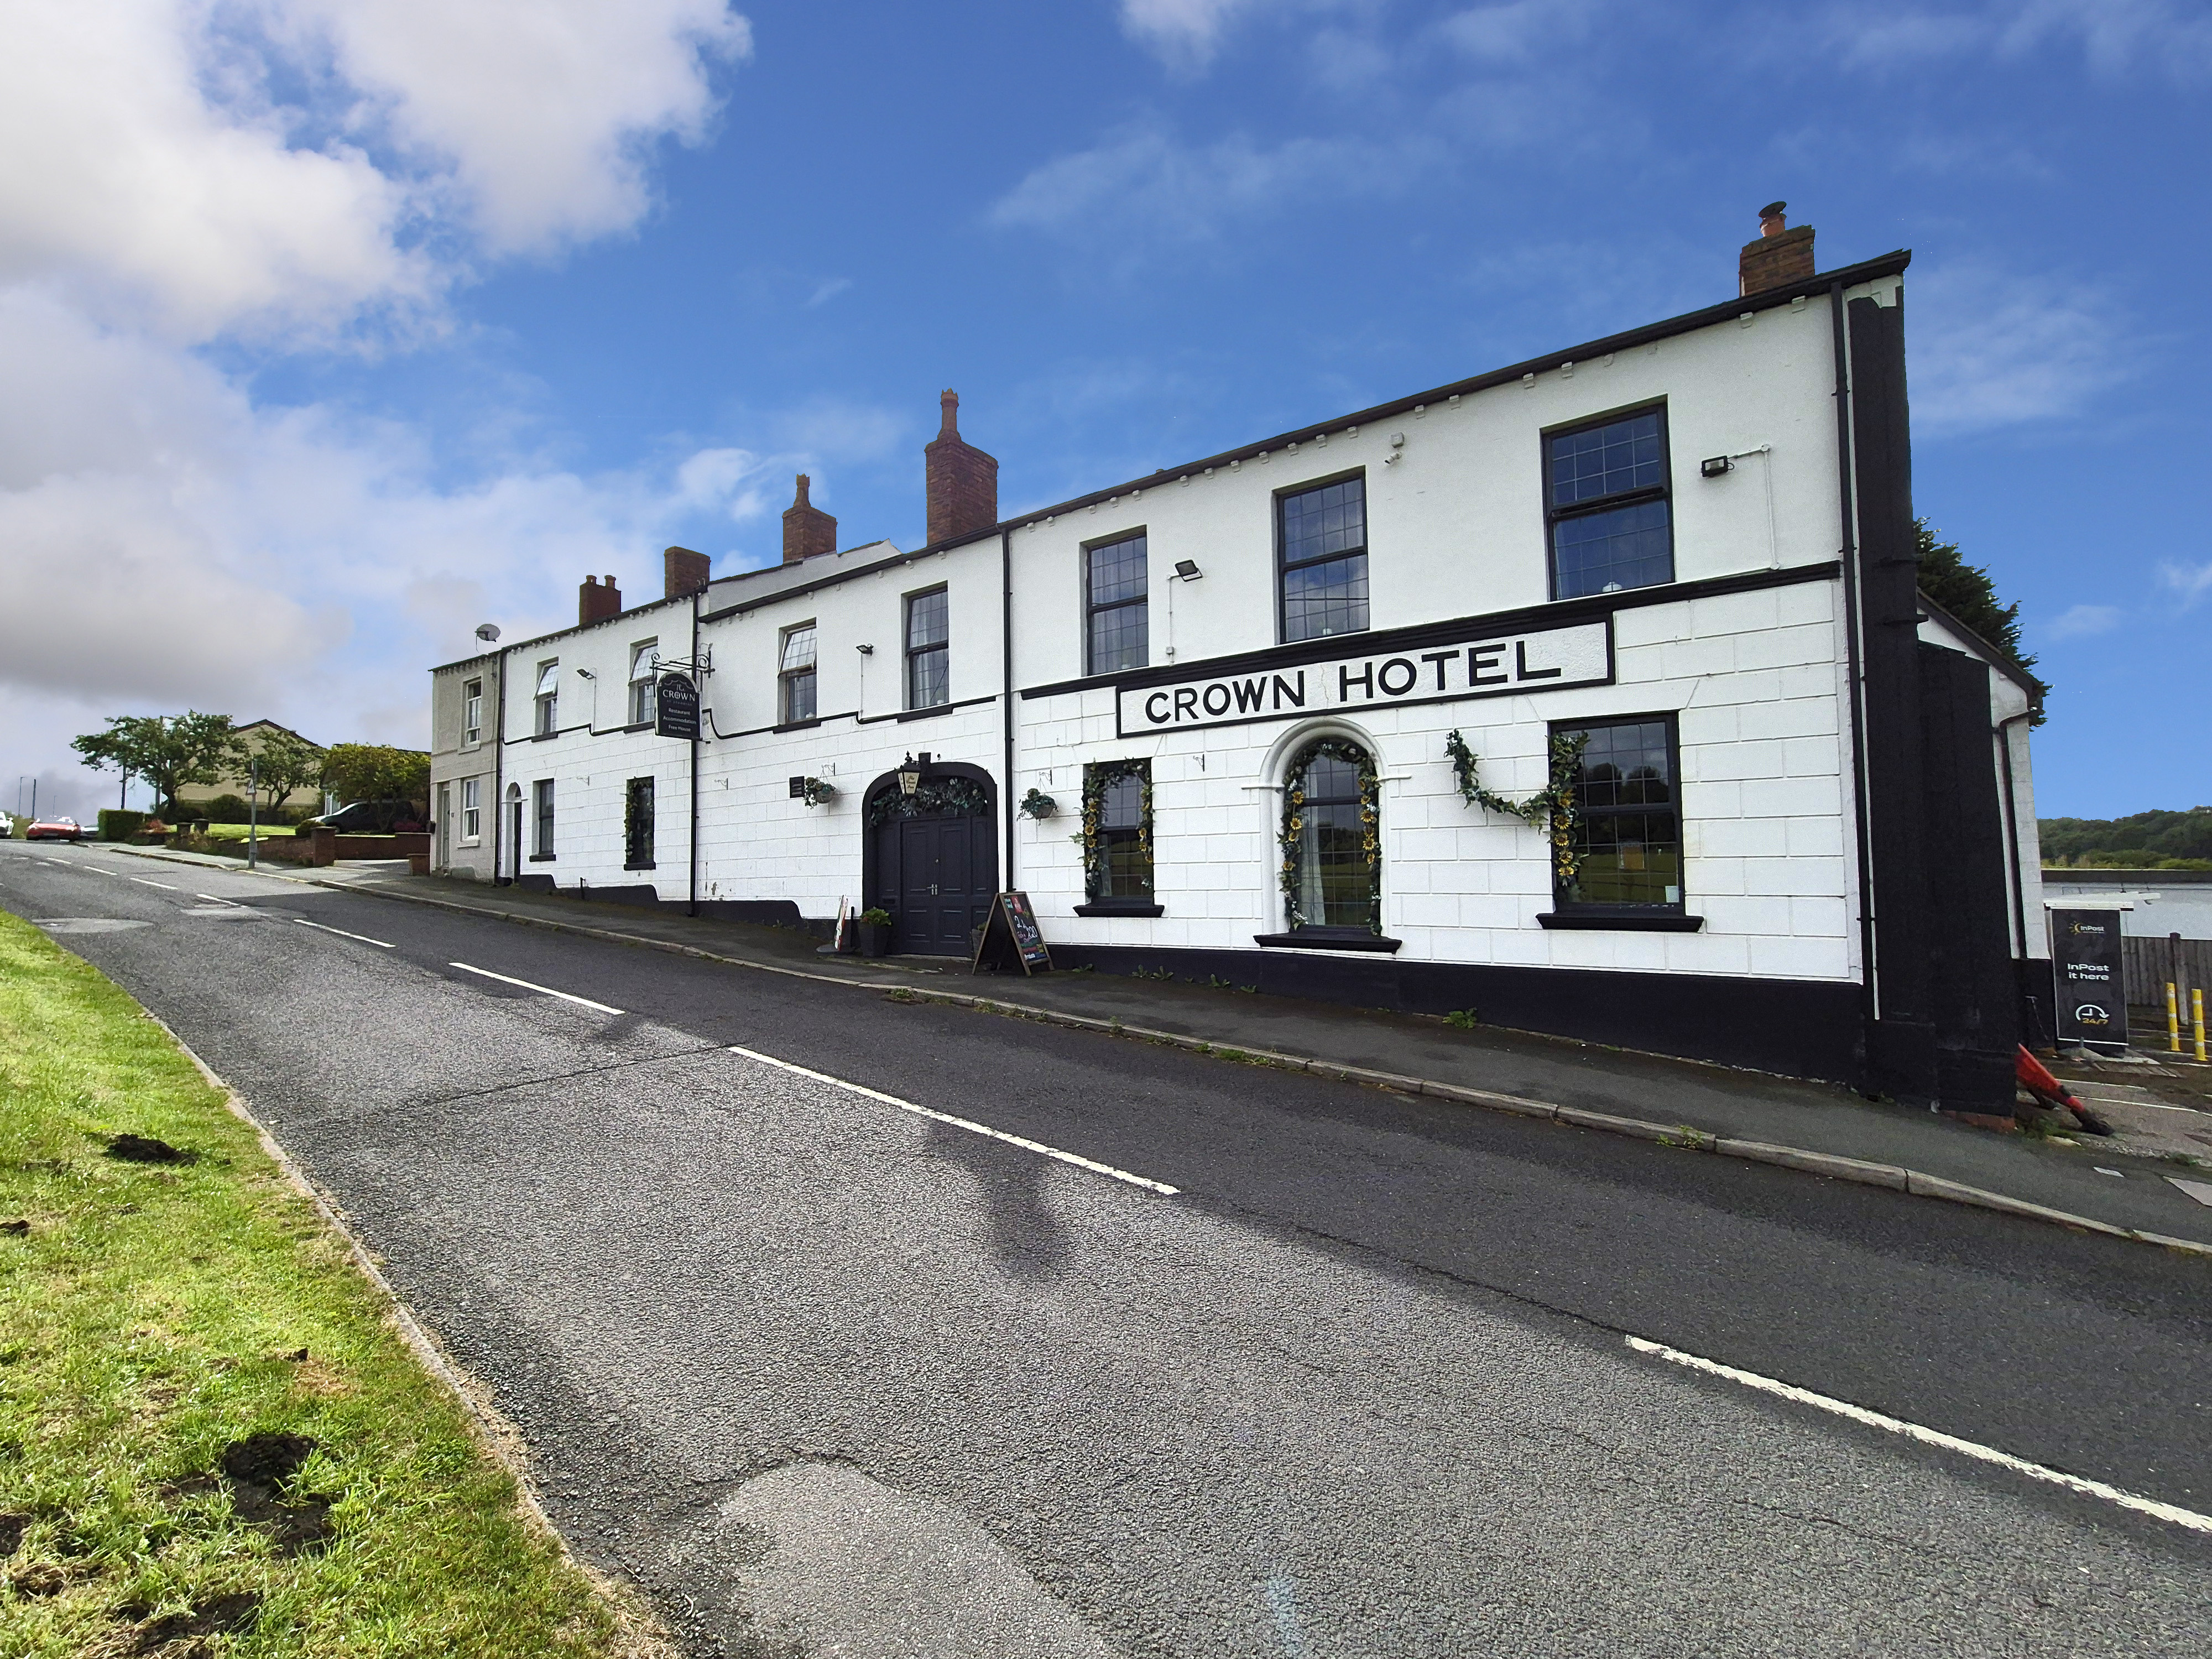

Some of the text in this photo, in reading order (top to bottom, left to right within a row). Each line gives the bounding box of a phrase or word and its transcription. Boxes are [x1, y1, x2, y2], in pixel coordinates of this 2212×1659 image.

[1145, 640, 1561, 724] CROWN HOTEL
[662, 689, 695, 702] CROWN
[668, 707, 690, 716] Restaurant
[662, 715, 697, 724] Accommodation
[2067, 963, 2110, 972] InPost
